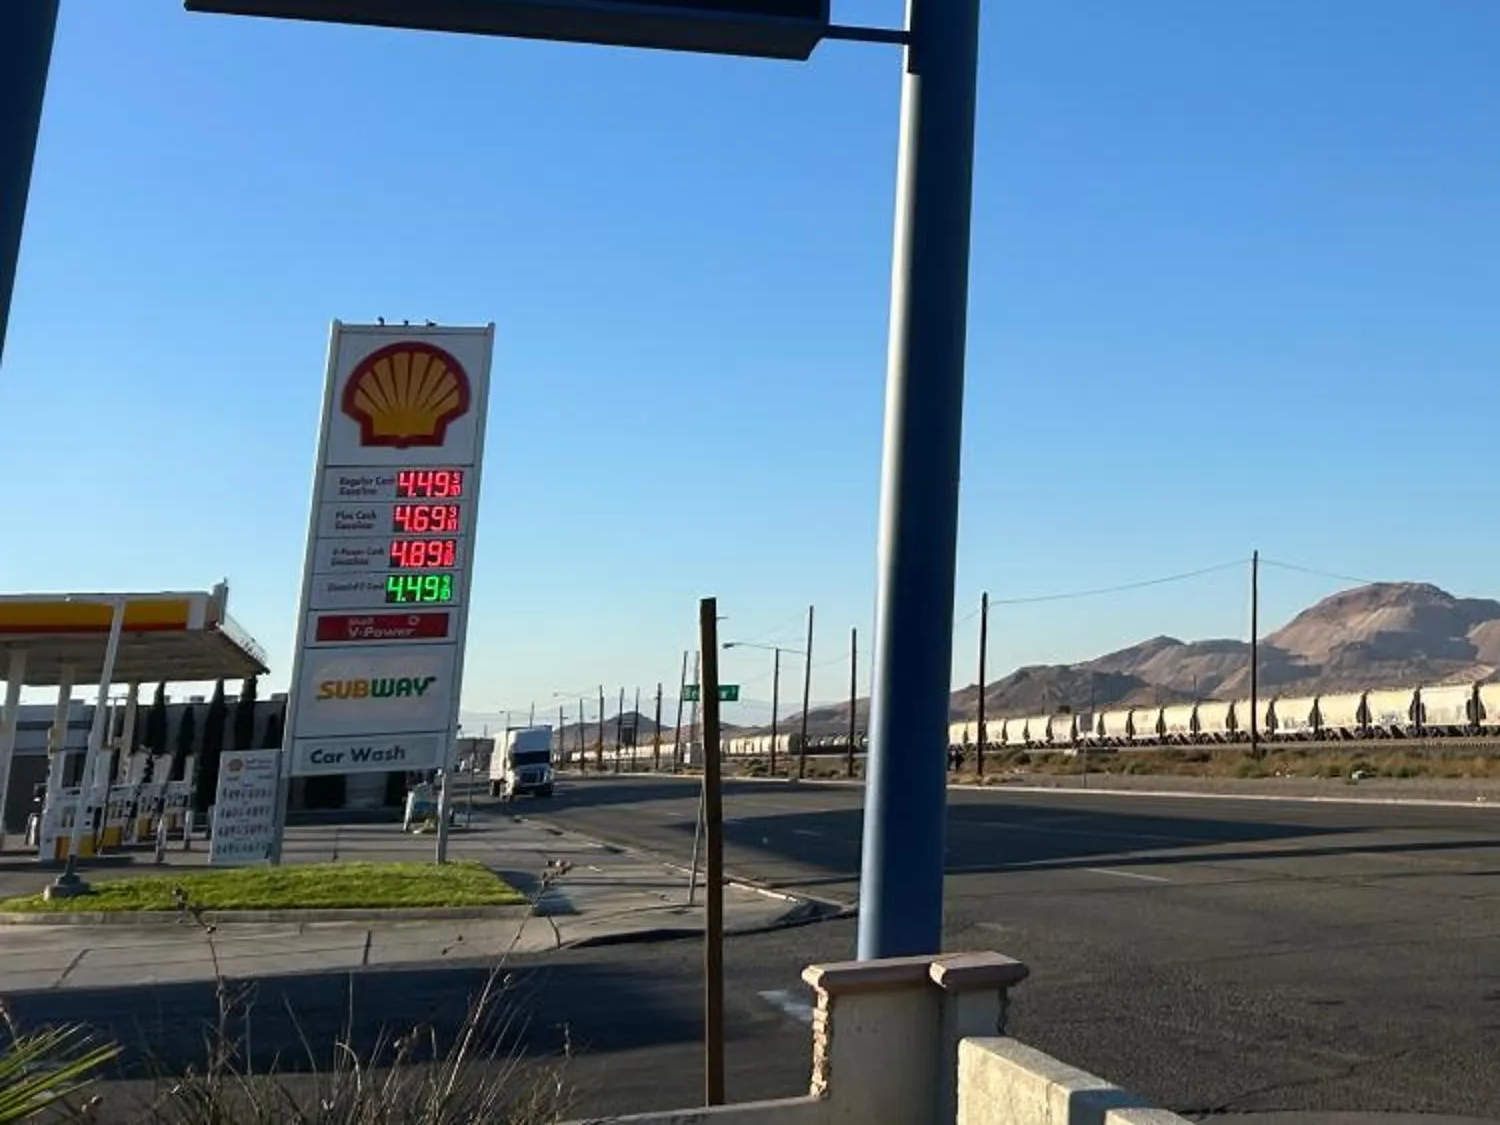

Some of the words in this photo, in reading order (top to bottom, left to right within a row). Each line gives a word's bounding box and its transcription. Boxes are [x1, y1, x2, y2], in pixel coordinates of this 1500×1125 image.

[316, 676, 437, 702] SUBWAY
[311, 748, 344, 765] Car
[351, 745, 406, 763] Wash
